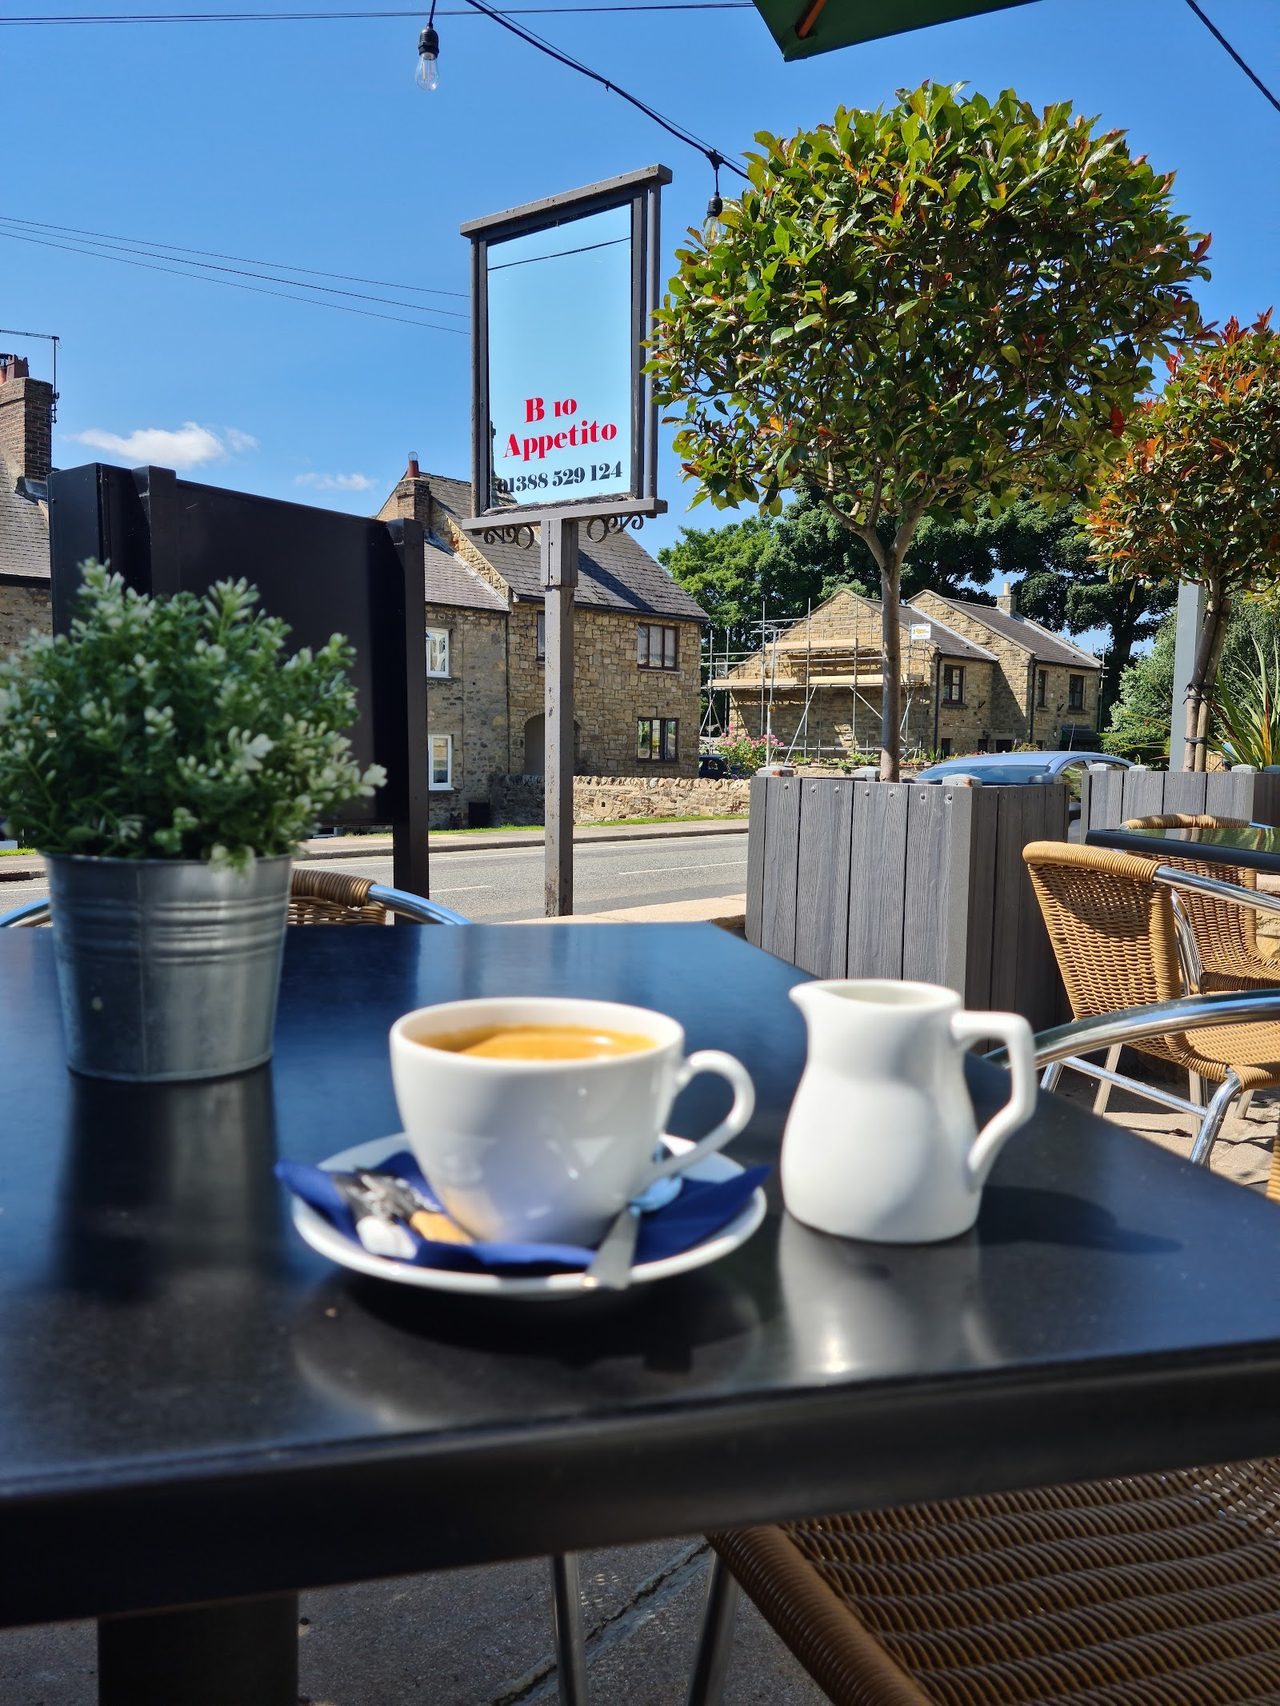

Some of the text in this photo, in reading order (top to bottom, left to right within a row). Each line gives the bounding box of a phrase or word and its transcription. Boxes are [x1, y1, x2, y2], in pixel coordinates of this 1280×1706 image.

[524, 397, 545, 424] B
[502, 420, 618, 462] Appetito
[497, 460, 623, 493] 01388 529 124
